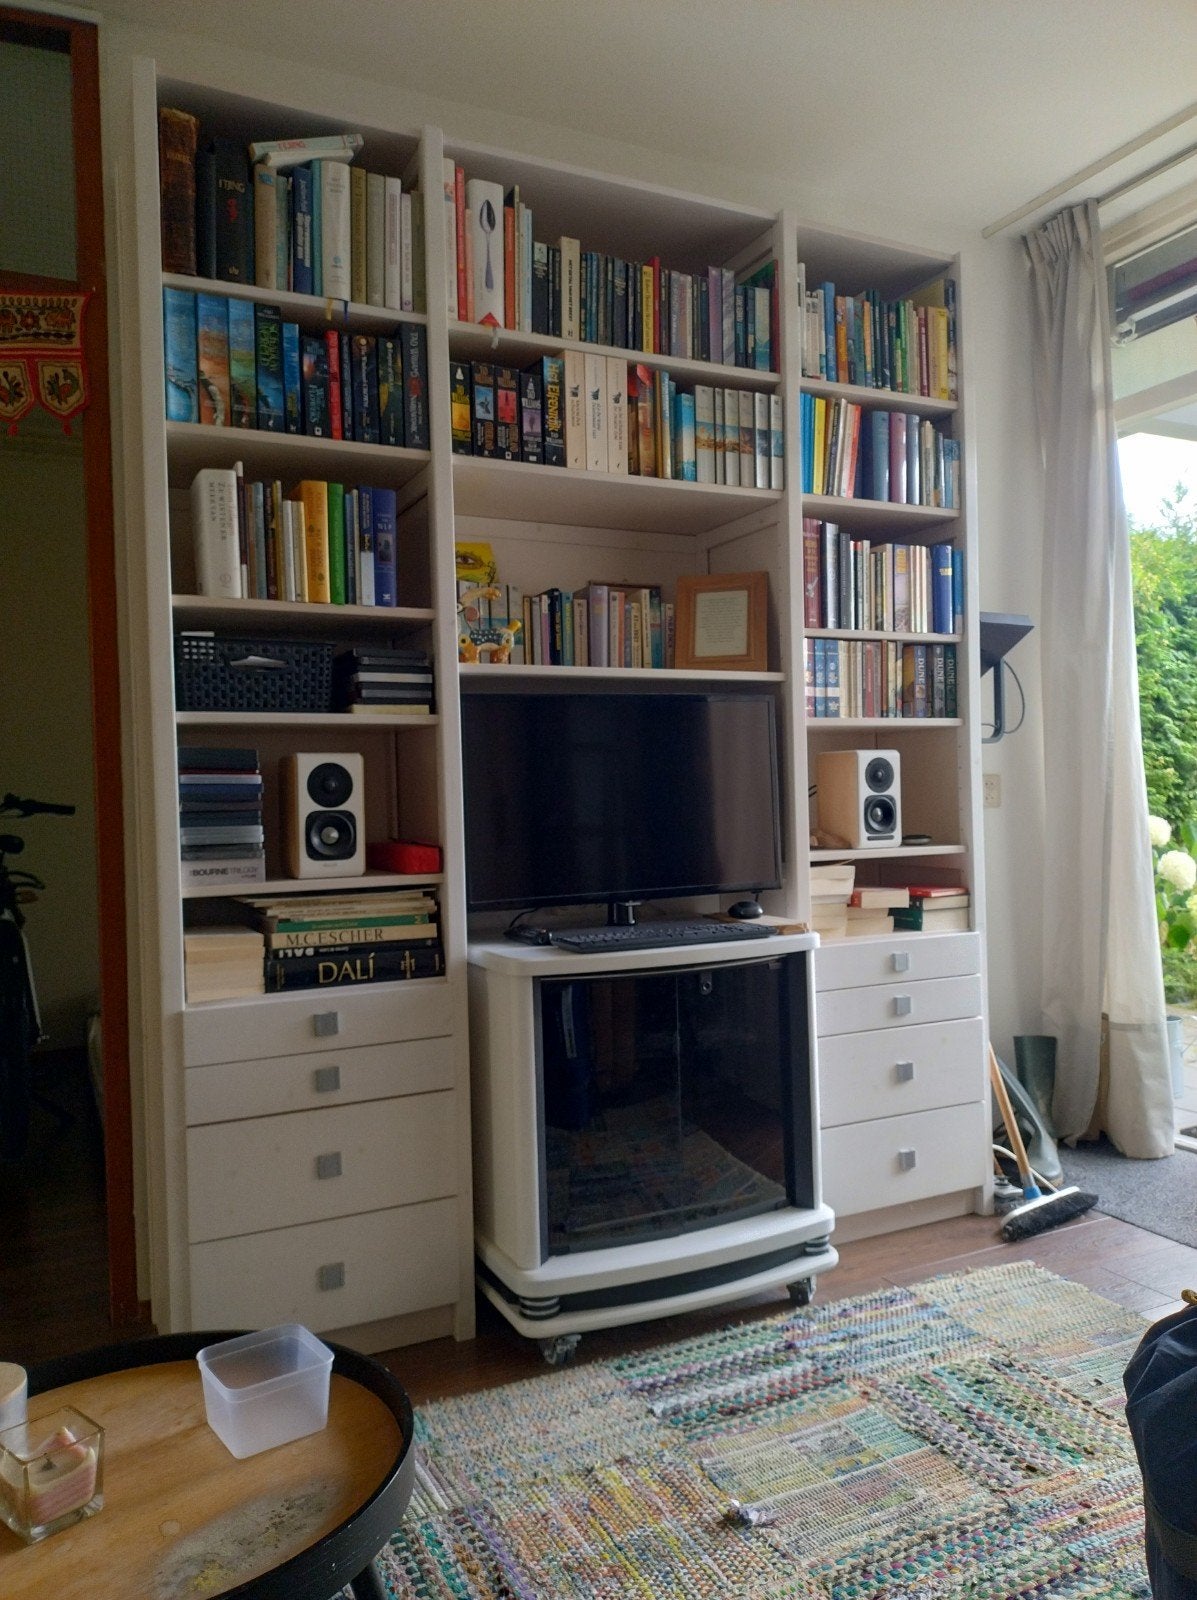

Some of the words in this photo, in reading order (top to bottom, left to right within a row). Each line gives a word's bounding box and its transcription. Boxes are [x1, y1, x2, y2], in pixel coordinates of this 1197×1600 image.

[917, 657, 925, 684] DUNE
[946, 659, 955, 684] DUNE
[192, 867, 228, 877] BOURNE
[278, 947, 315, 958] DALI
[317, 952, 376, 984] DALÍ
